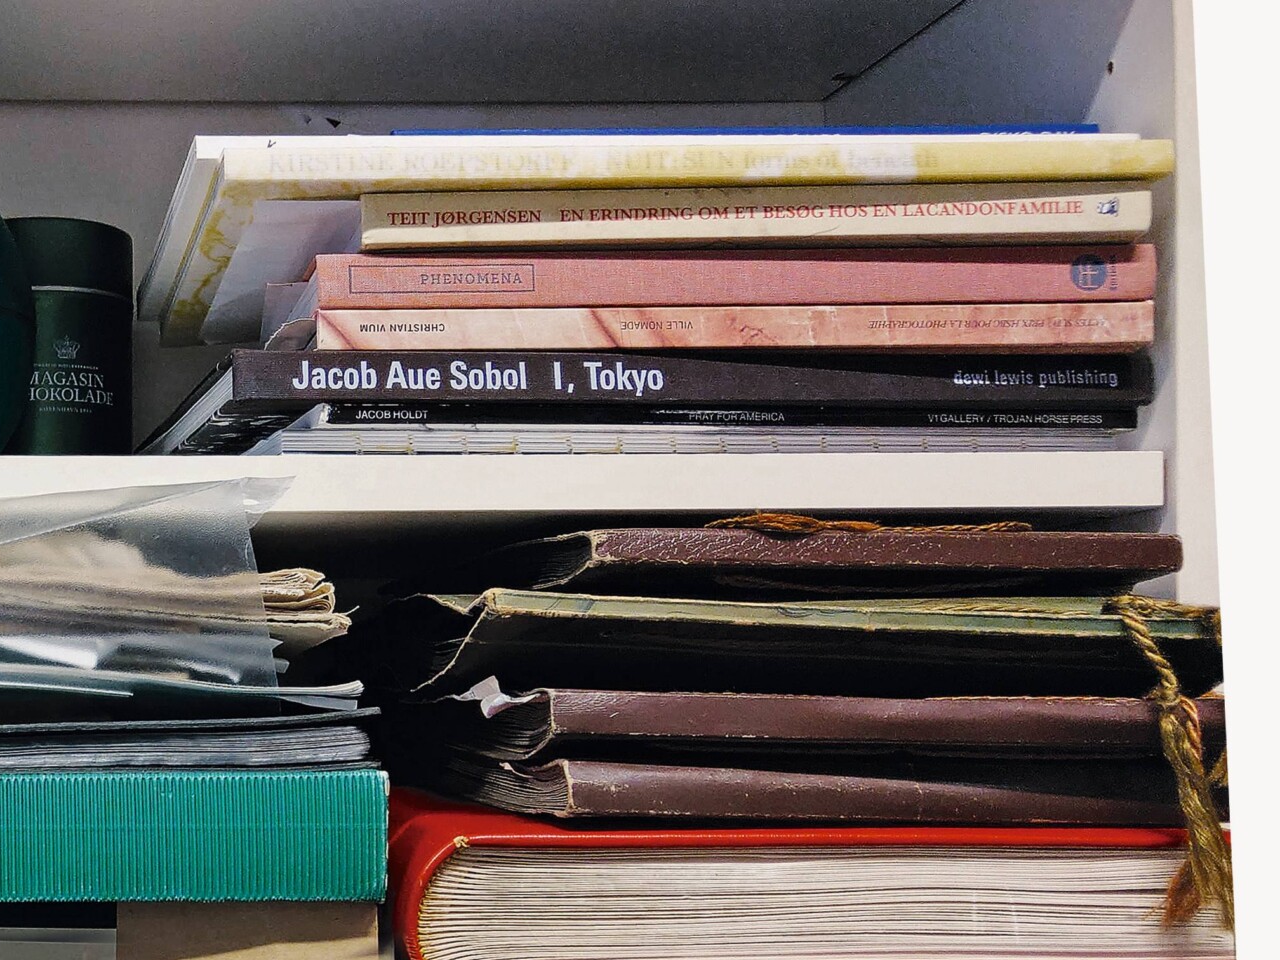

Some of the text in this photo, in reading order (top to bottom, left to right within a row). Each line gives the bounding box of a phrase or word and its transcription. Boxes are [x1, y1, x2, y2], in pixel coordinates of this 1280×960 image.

[387, 201, 1083, 227] TEIT JØRGENSEN EN ERINDRING OM ET BESØG HOS EN LACANDONFAMILIE
[420, 273, 523, 285] PHENOMENA
[359, 323, 446, 333] CHRISTIAN VIUM
[620, 320, 694, 331] VILLE NOMADE
[868, 319, 948, 329] PHOTOGRAPHIE
[950, 319, 964, 329] LA
[965, 319, 992, 329] POUR
[292, 360, 378, 390] Jacob
[385, 361, 442, 390] Aue
[450, 360, 528, 390] Sobol
[583, 361, 664, 397] Tokyo
[953, 369, 1119, 388] dewi lewis publishing
[355, 410, 428, 420] JACOB HOLDT
[689, 412, 785, 421] PRAY FOR AMERICA
[940, 414, 985, 423] GALLERY
[993, 414, 1033, 424] TROJAN
[1035, 415, 1069, 424] HORSE
[1070, 415, 1103, 424] PRESS
